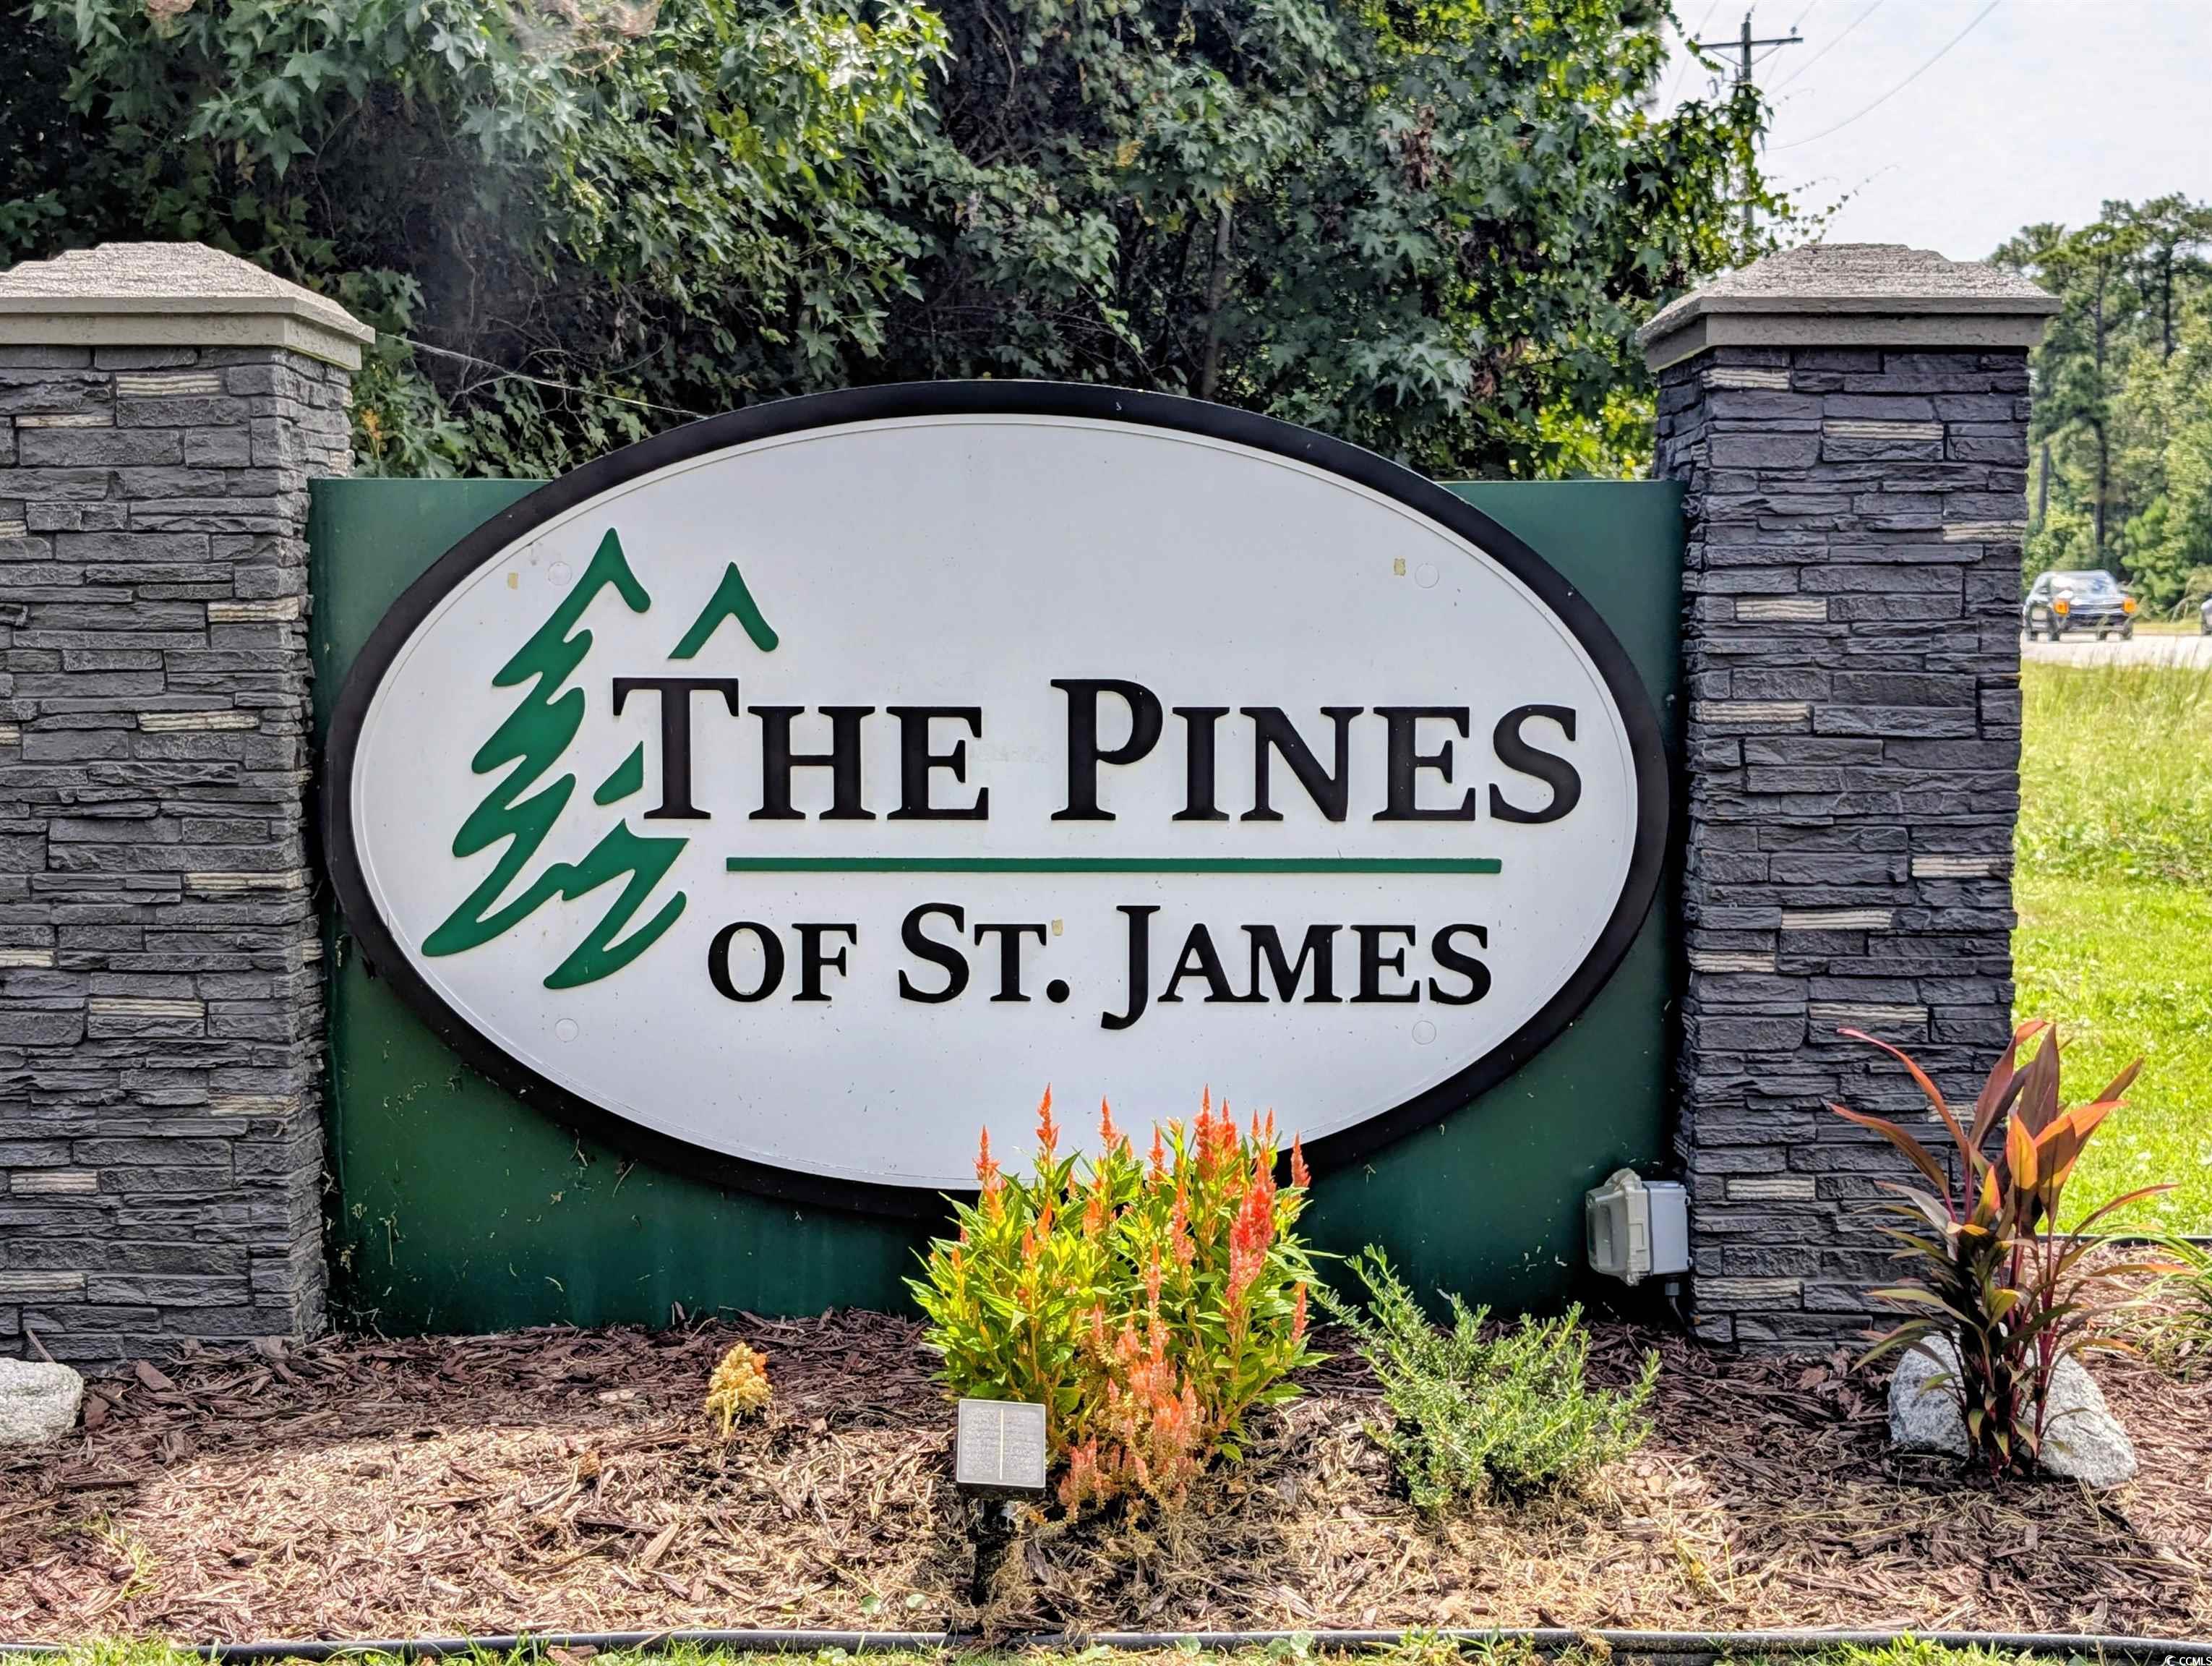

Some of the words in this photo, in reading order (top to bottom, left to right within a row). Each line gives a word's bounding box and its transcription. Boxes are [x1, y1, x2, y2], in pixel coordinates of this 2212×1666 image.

[612, 678, 989, 821] THE
[1050, 678, 1582, 824] PINES
[708, 921, 857, 1003] OF
[899, 902, 1070, 1004] ST.
[1100, 905, 1491, 1030] JAMES
